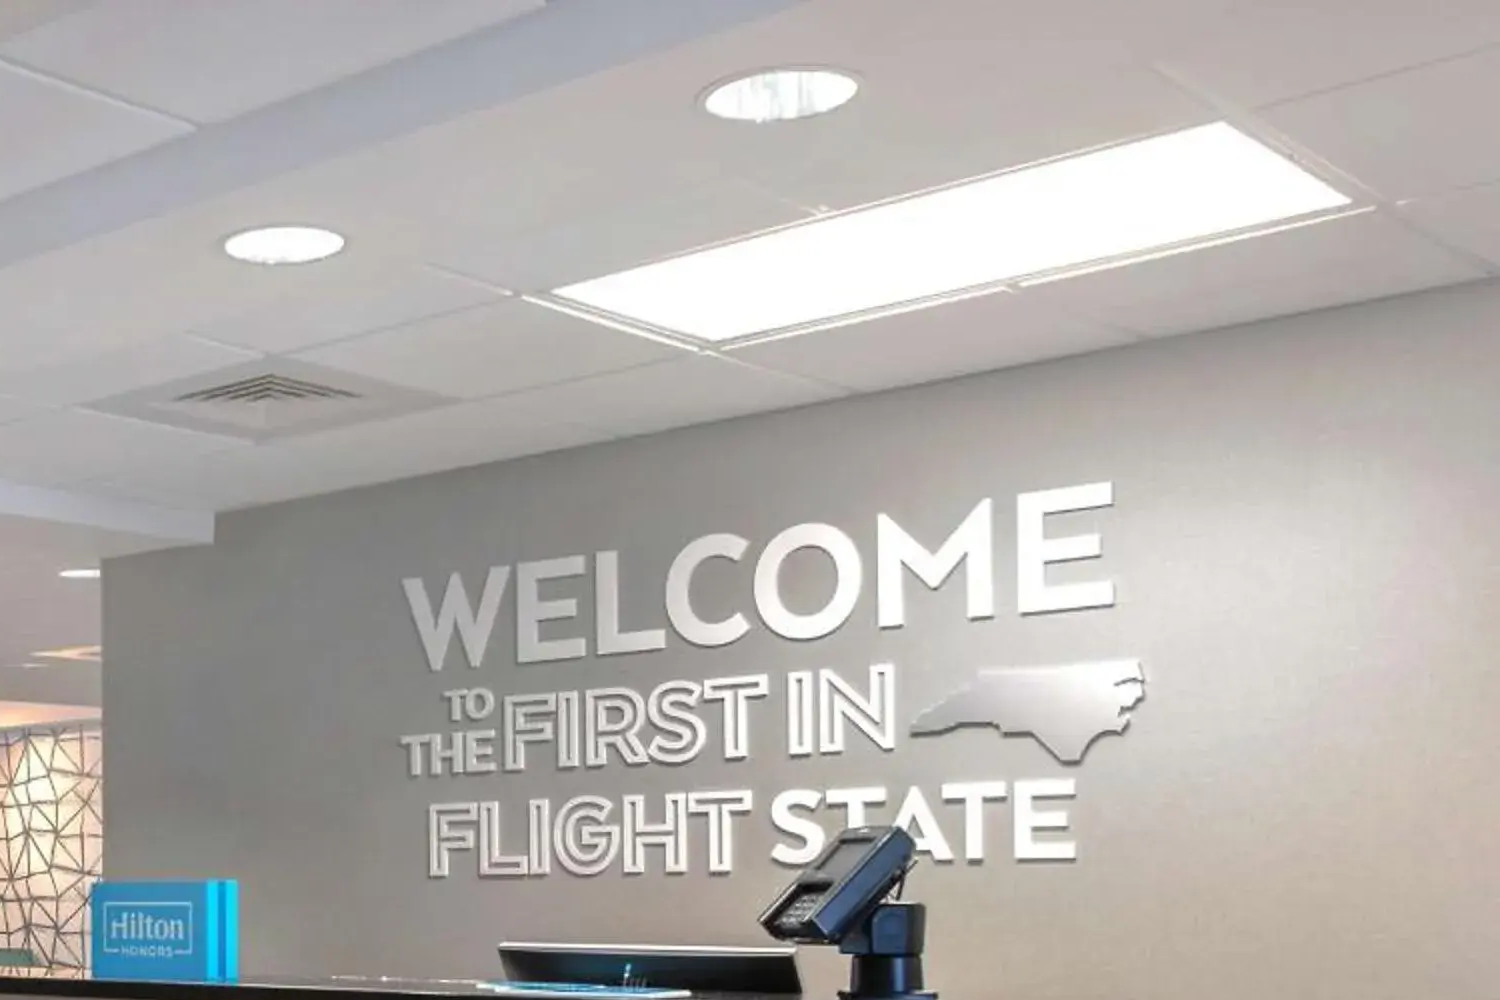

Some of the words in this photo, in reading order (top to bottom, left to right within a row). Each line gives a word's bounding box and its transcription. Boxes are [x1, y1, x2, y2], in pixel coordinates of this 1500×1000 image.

[401, 480, 1115, 672] WELCOME
[399, 730, 497, 777] THE
[502, 672, 768, 771] FIRST
[787, 662, 897, 758] IN
[444, 686, 496, 722] TO
[428, 790, 753, 879] FLIGHT
[771, 778, 1077, 866] STATE
[111, 911, 184, 940] Hilton
[121, 945, 173, 957] HONORS
